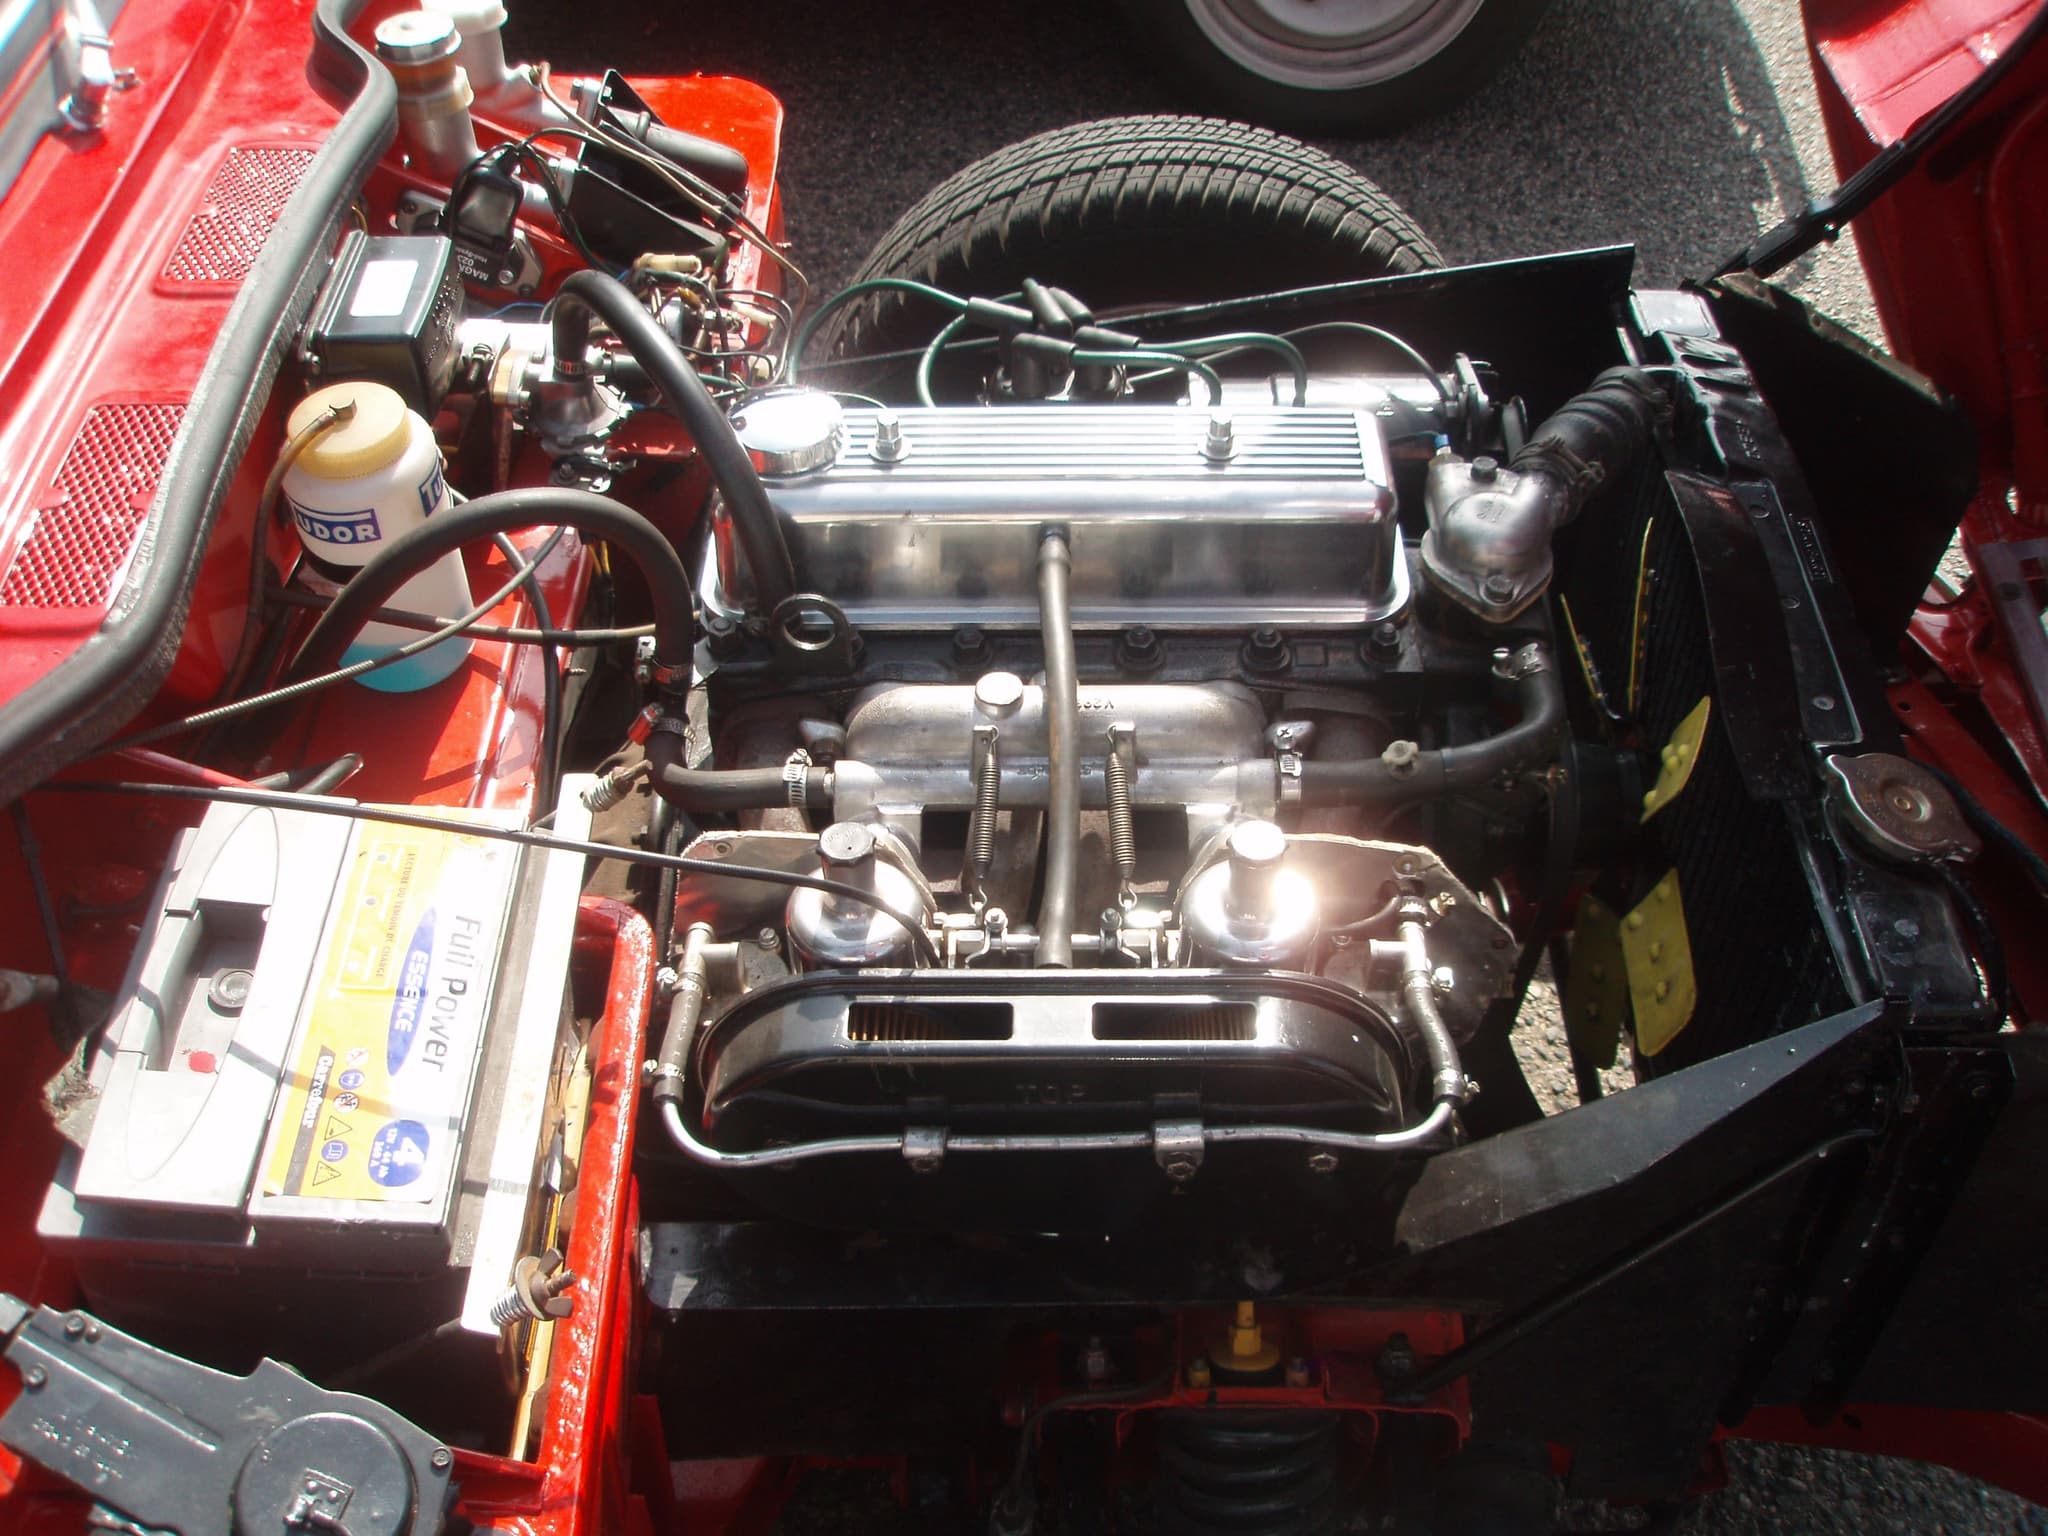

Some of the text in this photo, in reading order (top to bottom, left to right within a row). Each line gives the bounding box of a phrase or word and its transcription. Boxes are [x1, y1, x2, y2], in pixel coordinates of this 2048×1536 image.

[394, 950, 430, 1032] ESSENCE
[421, 914, 482, 1072] Full Power
[302, 1055, 333, 1129] Carrefour
[391, 1136, 426, 1166] 4
